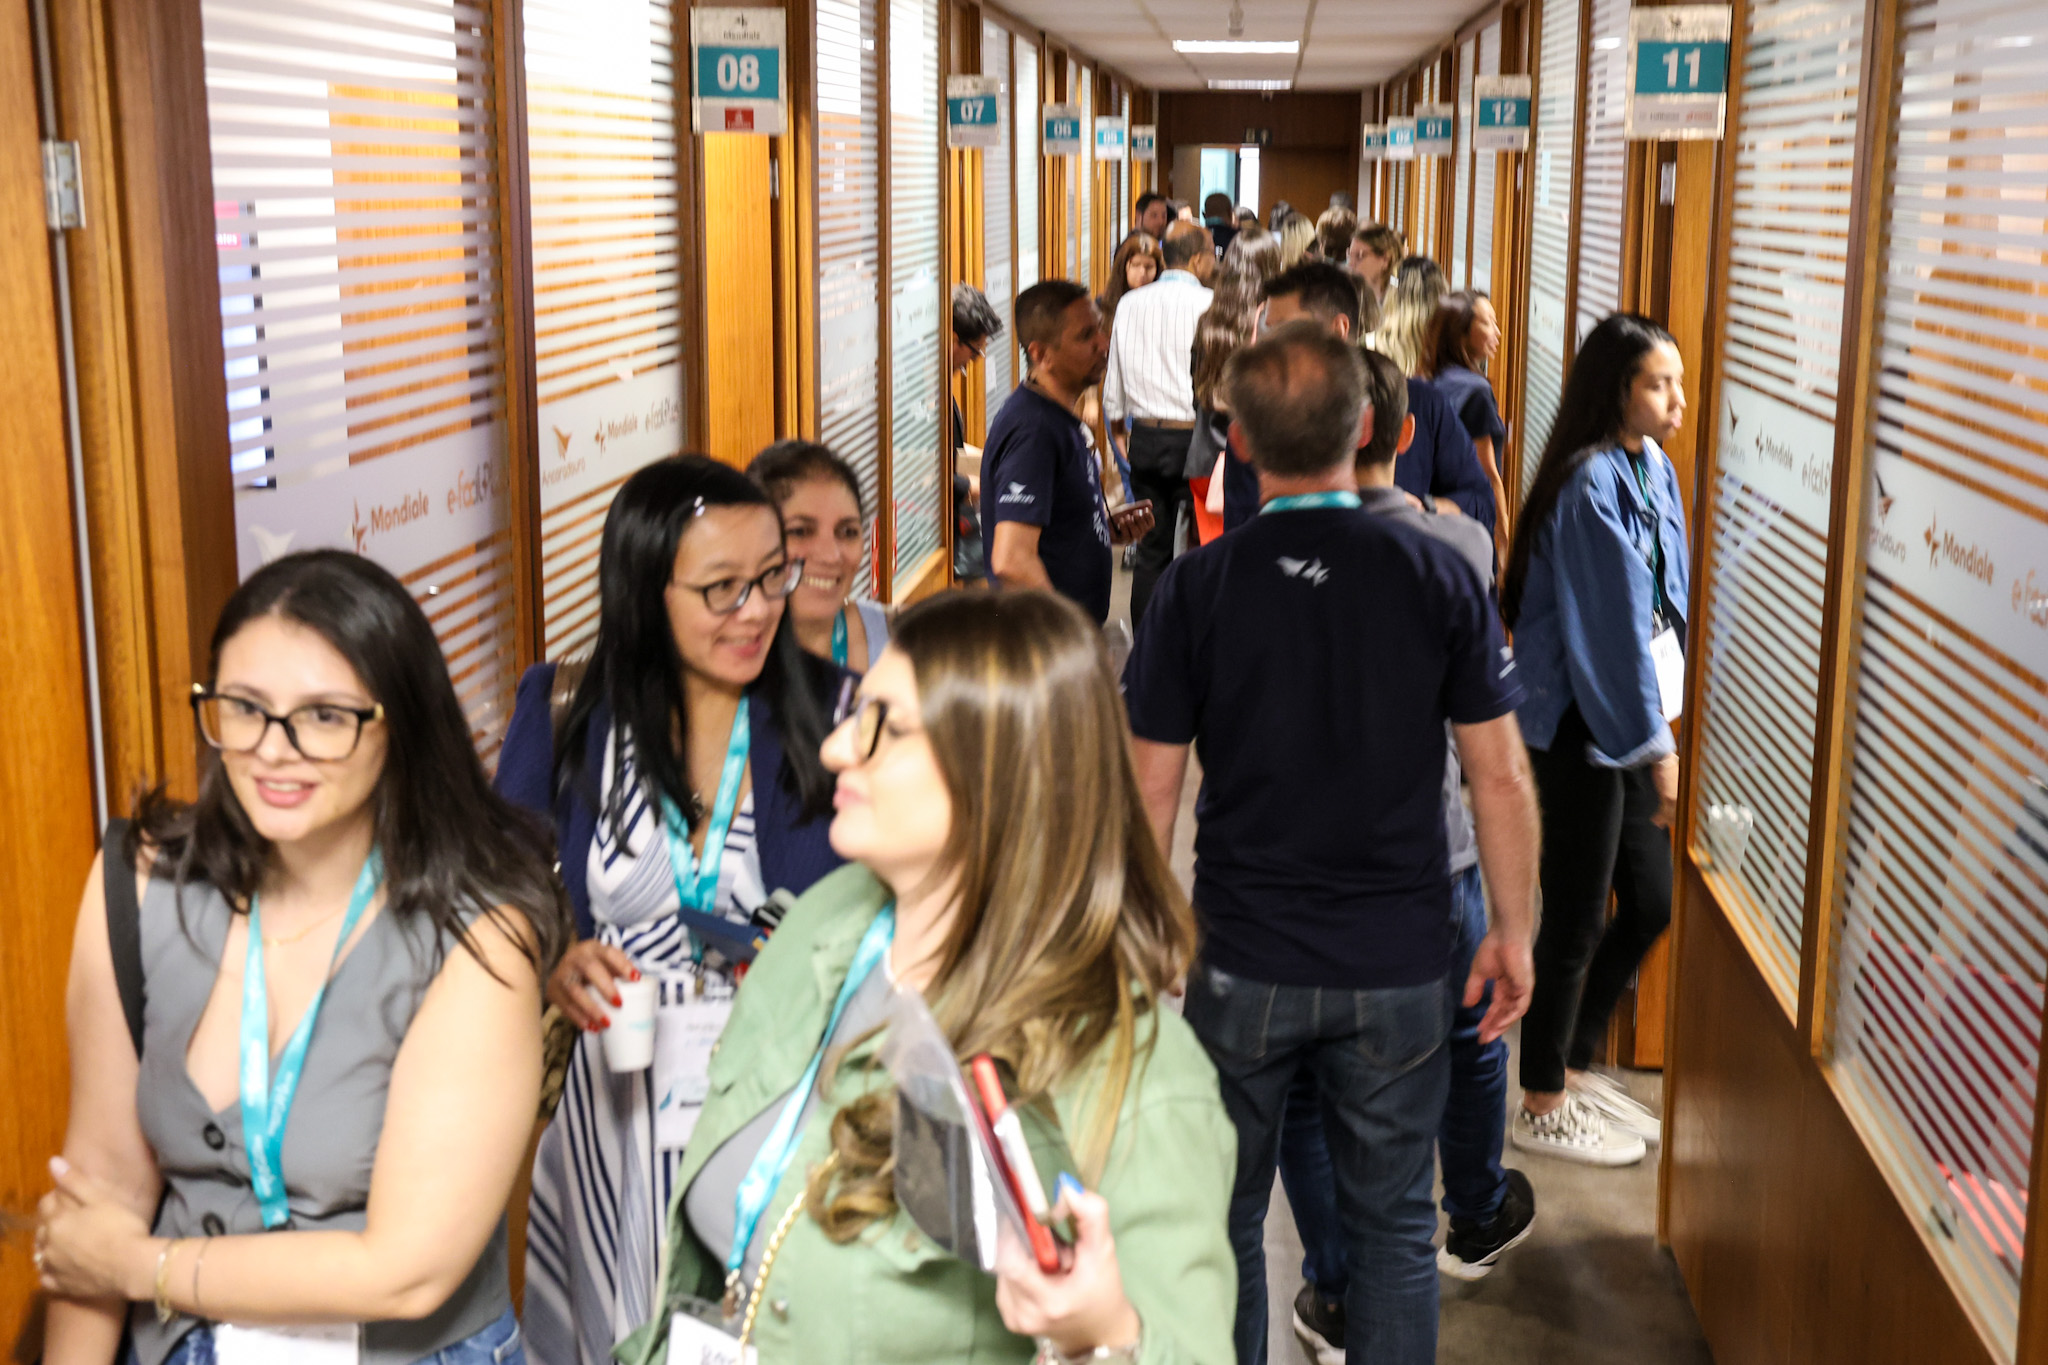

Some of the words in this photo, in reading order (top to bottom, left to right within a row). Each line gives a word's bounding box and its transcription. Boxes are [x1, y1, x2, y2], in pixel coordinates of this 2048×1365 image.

[716, 53, 760, 93] 08
[1662, 47, 1701, 89] 11
[960, 99, 985, 123] 07
[1425, 119, 1443, 138] 01
[1491, 101, 1517, 126] 12
[370, 488, 429, 536] Mondiale
[1942, 528, 1995, 587] Mondiale
